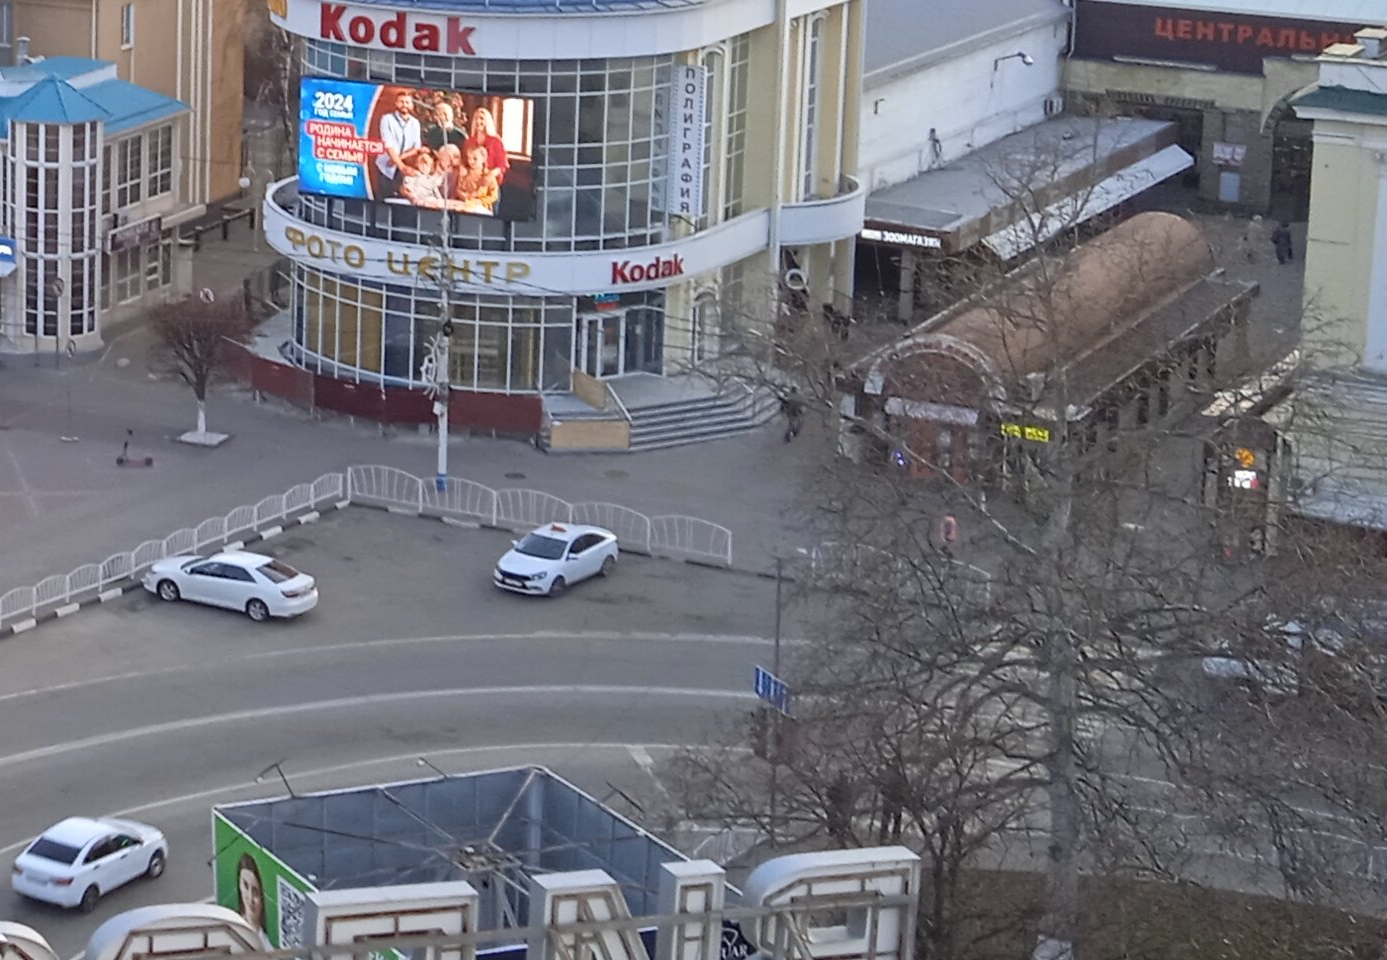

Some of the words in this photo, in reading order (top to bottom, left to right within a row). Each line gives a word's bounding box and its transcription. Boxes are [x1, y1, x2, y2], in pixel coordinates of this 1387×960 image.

[320, 2, 476, 56] Kodak
[313, 91, 354, 111] 2024
[309, 122, 352, 137] РОДИНА
[316, 136, 384, 153] НАЧИНАЕТСЯ
[679, 68, 696, 214] ПОЛИГРАФИЯ
[316, 147, 325, 158] С
[284, 224, 366, 269] ФОТО
[386, 250, 532, 284] ЦЕНТР
[610, 253, 685, 285] Kodak
